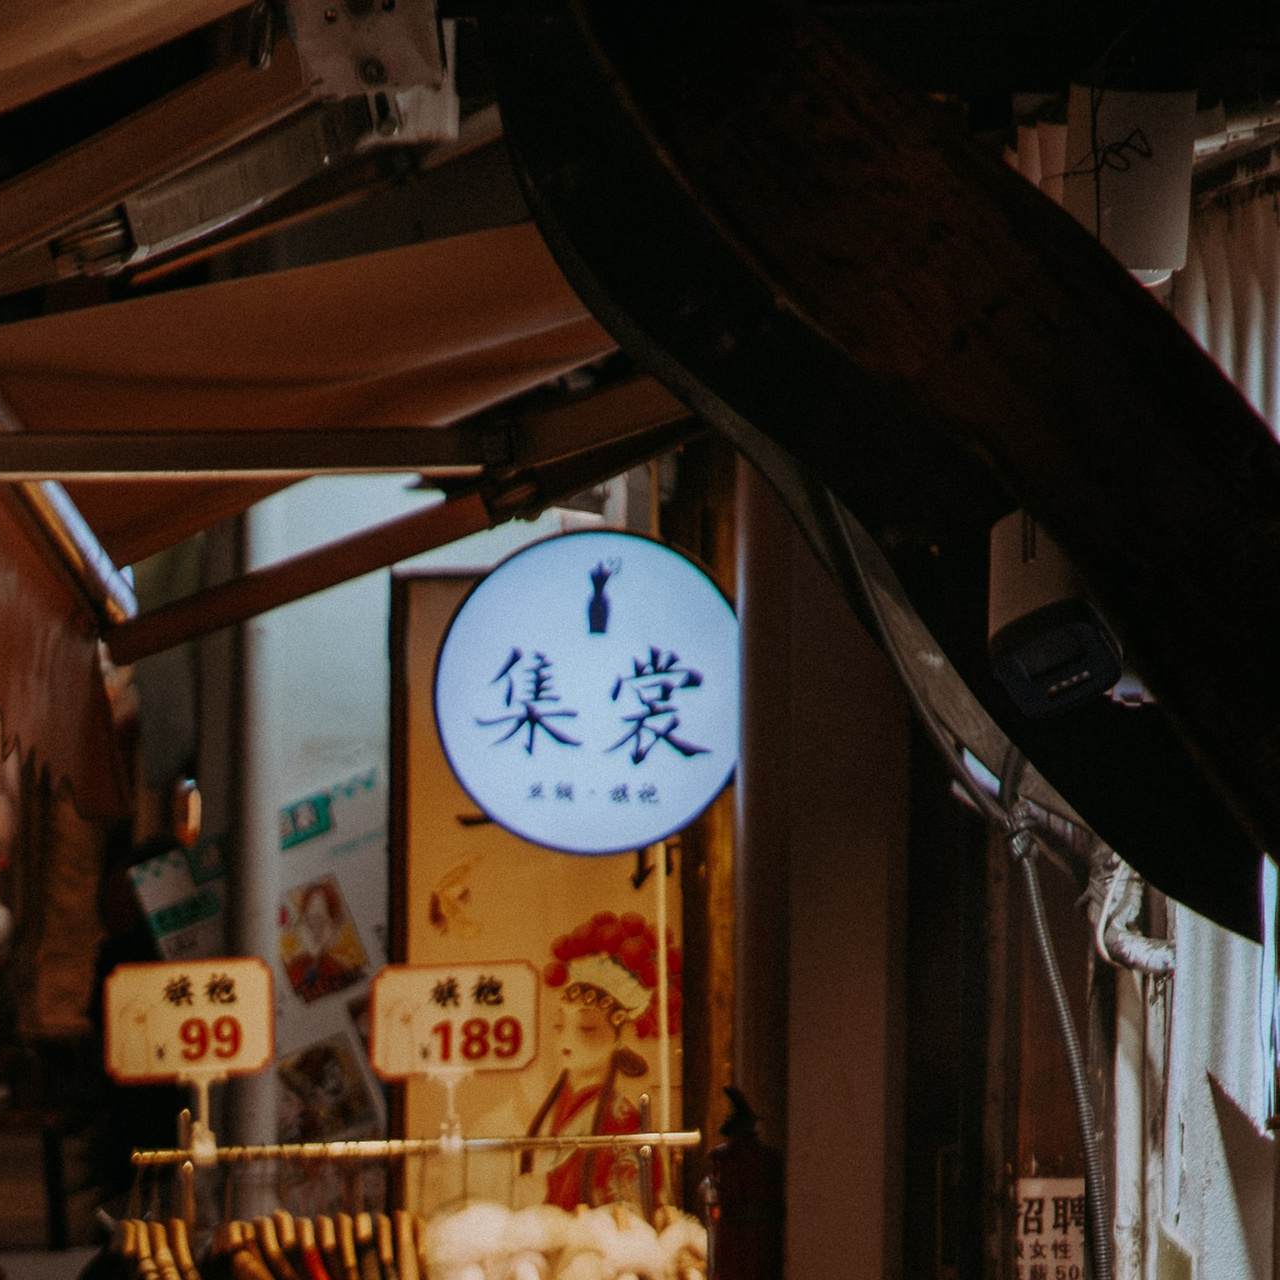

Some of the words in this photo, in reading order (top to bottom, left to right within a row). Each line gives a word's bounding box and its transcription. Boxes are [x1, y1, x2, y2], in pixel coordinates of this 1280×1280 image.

[475, 646, 711, 764] 集裳
[163, 973, 237, 1006] 旗袍
[431, 975, 504, 1006] 旗袍
[1015, 1239, 1085, 1260] 女性
